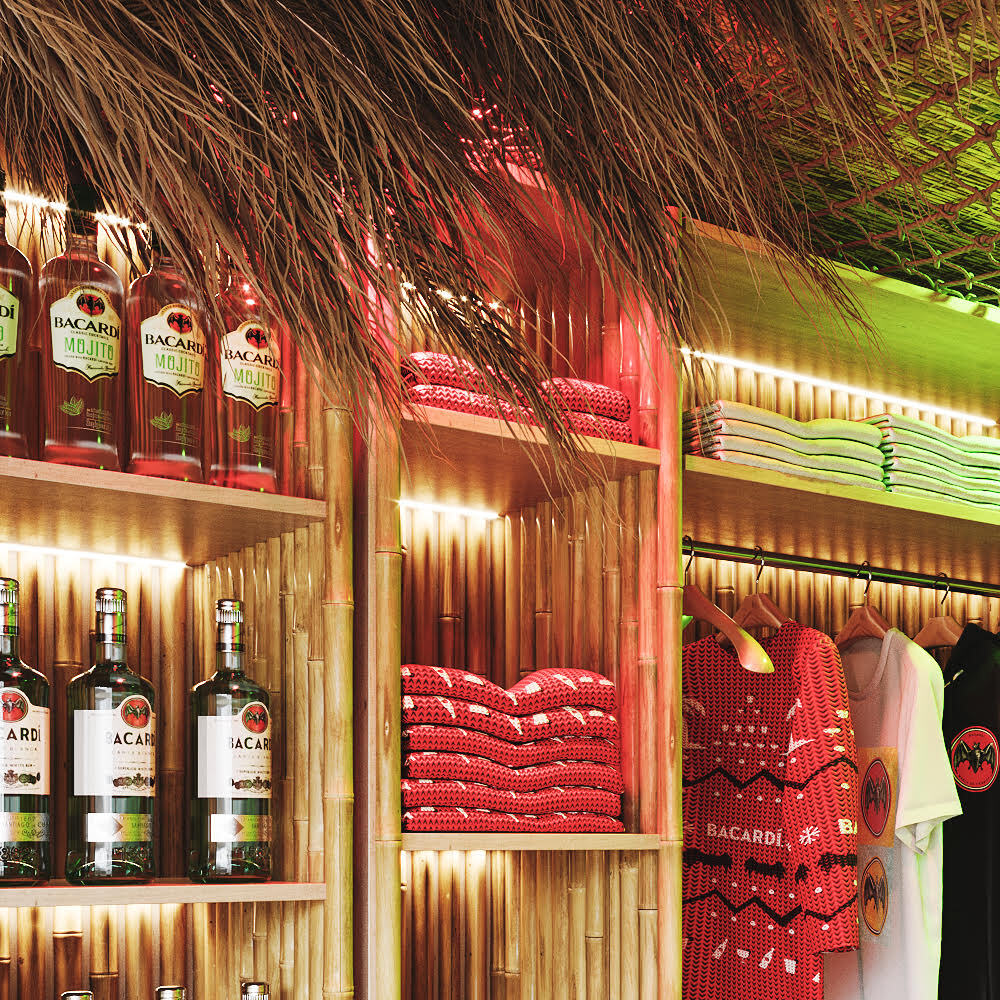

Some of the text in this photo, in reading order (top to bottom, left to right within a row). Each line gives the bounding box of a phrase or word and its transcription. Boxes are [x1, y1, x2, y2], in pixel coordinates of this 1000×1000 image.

[64, 336, 114, 361] MOJITO
[224, 349, 279, 370] BACARD
[155, 352, 200, 377] MOJITO
[234, 367, 276, 391] MOJITO
